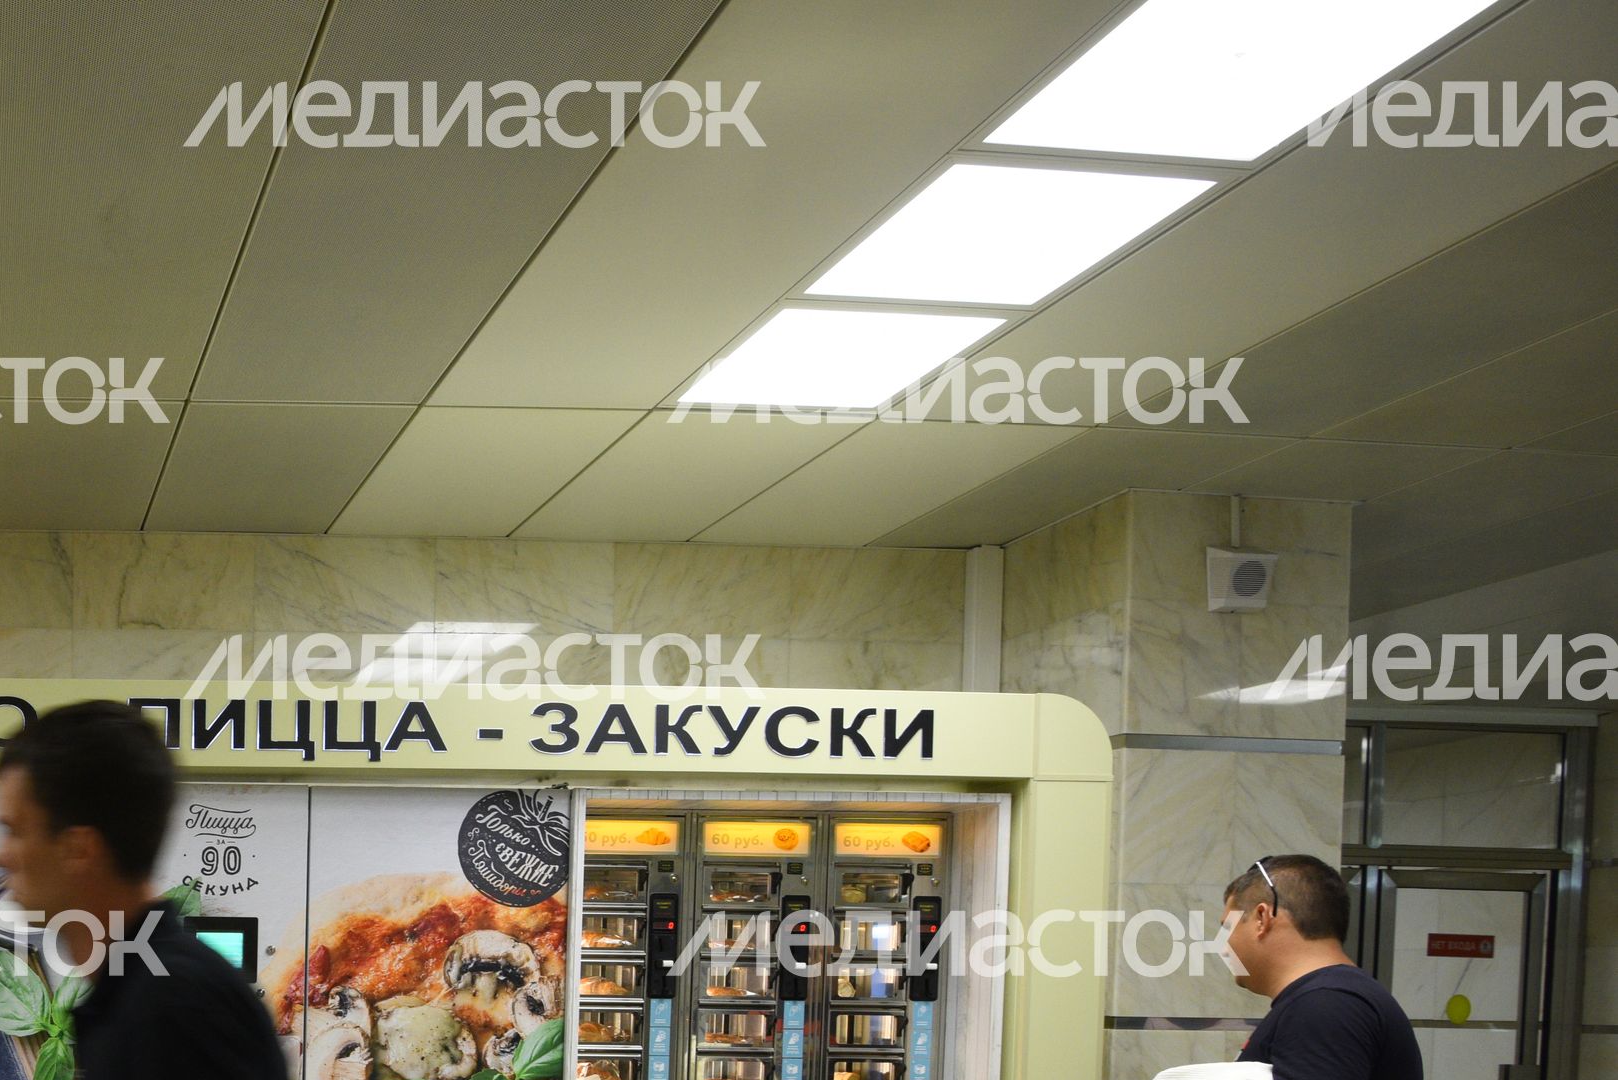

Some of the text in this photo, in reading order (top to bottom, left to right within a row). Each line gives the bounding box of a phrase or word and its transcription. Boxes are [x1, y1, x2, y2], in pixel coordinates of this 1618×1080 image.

[127, 697, 448, 763] ПИЦЦА
[529, 702, 935, 760] ЗАКУСКИ
[711, 833, 729, 845] 60
[842, 836, 861, 847] 60
[201, 846, 241, 876] 90
